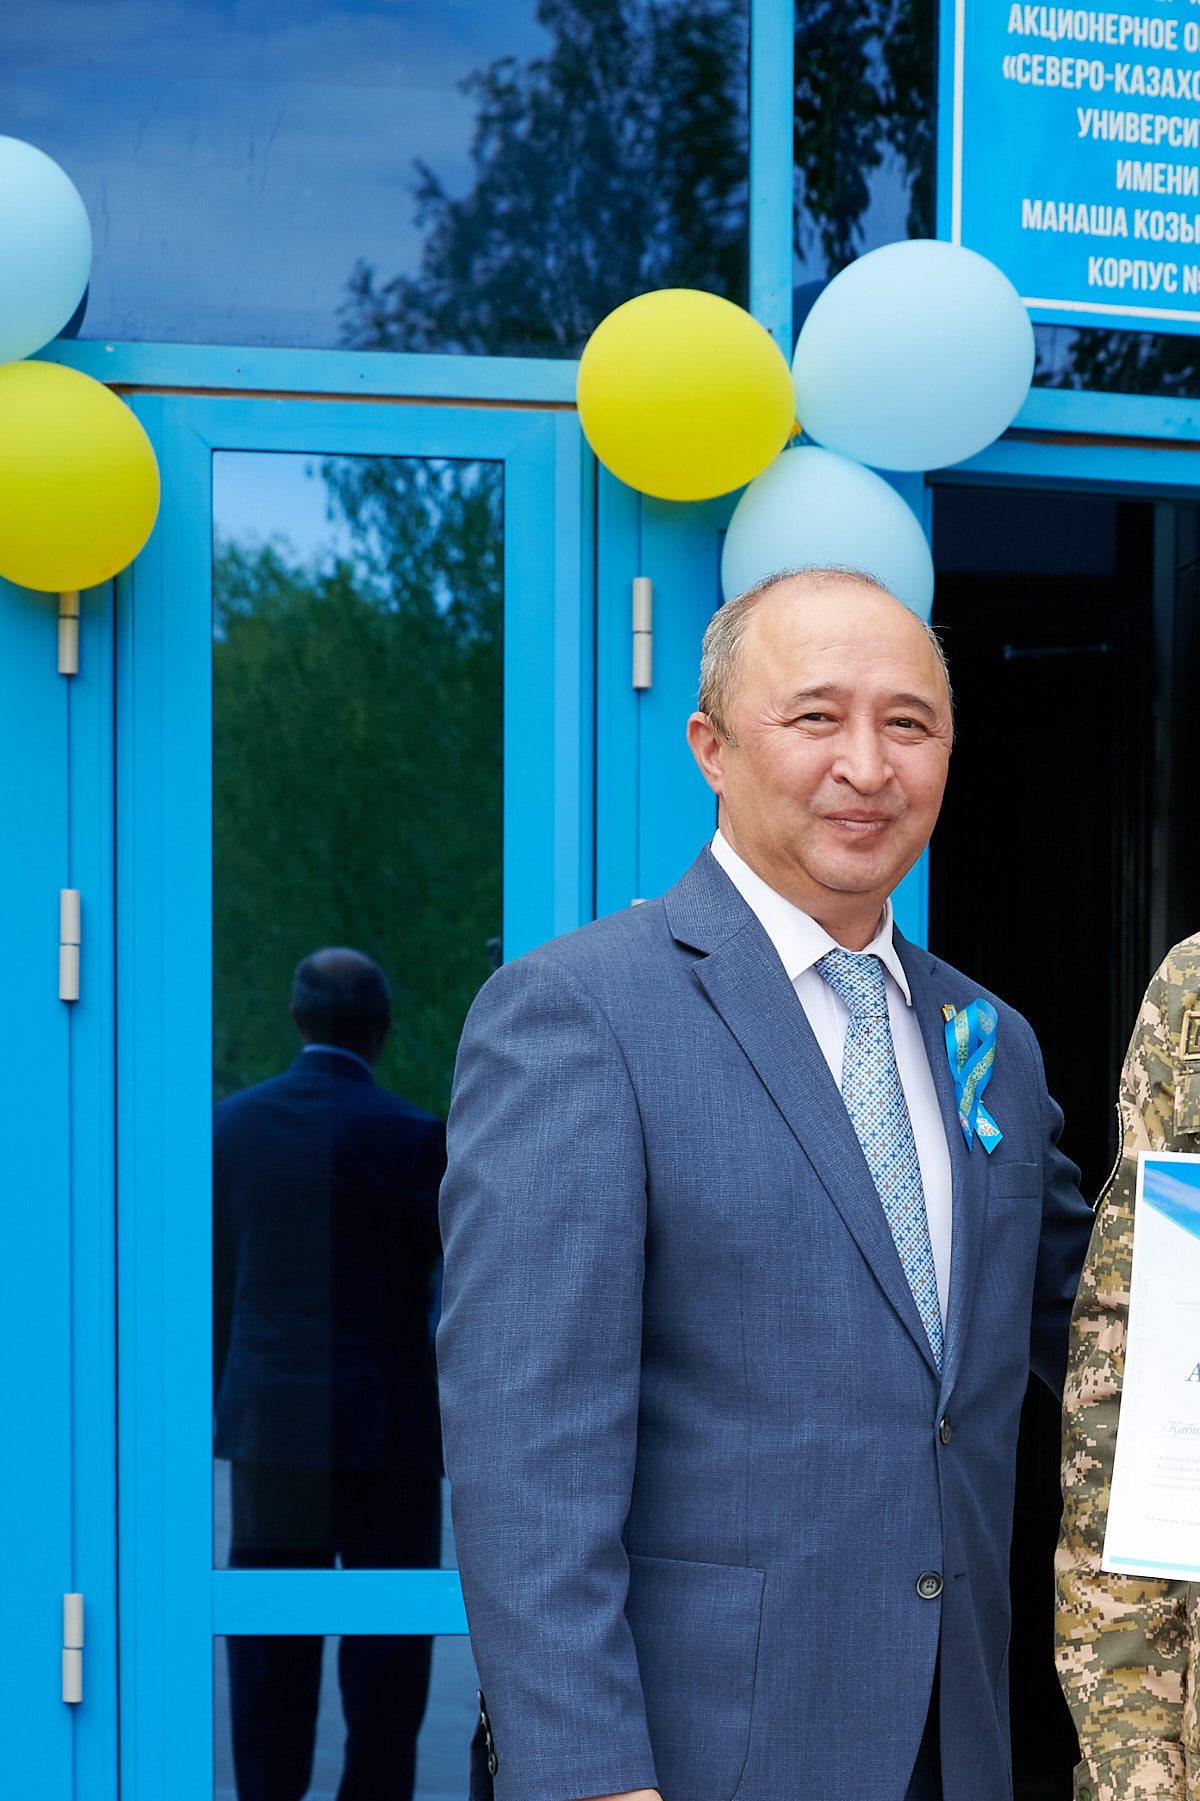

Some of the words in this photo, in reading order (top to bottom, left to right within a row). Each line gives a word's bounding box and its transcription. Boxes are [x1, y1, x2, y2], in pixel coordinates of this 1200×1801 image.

[1007, 4, 1178, 51] АКЦИОНЕРНОЕ
[1116, 159, 1199, 197] ИМЕНИ
[1022, 199, 1129, 238] МАНАША
[1088, 256, 1178, 292] КОРПУС
